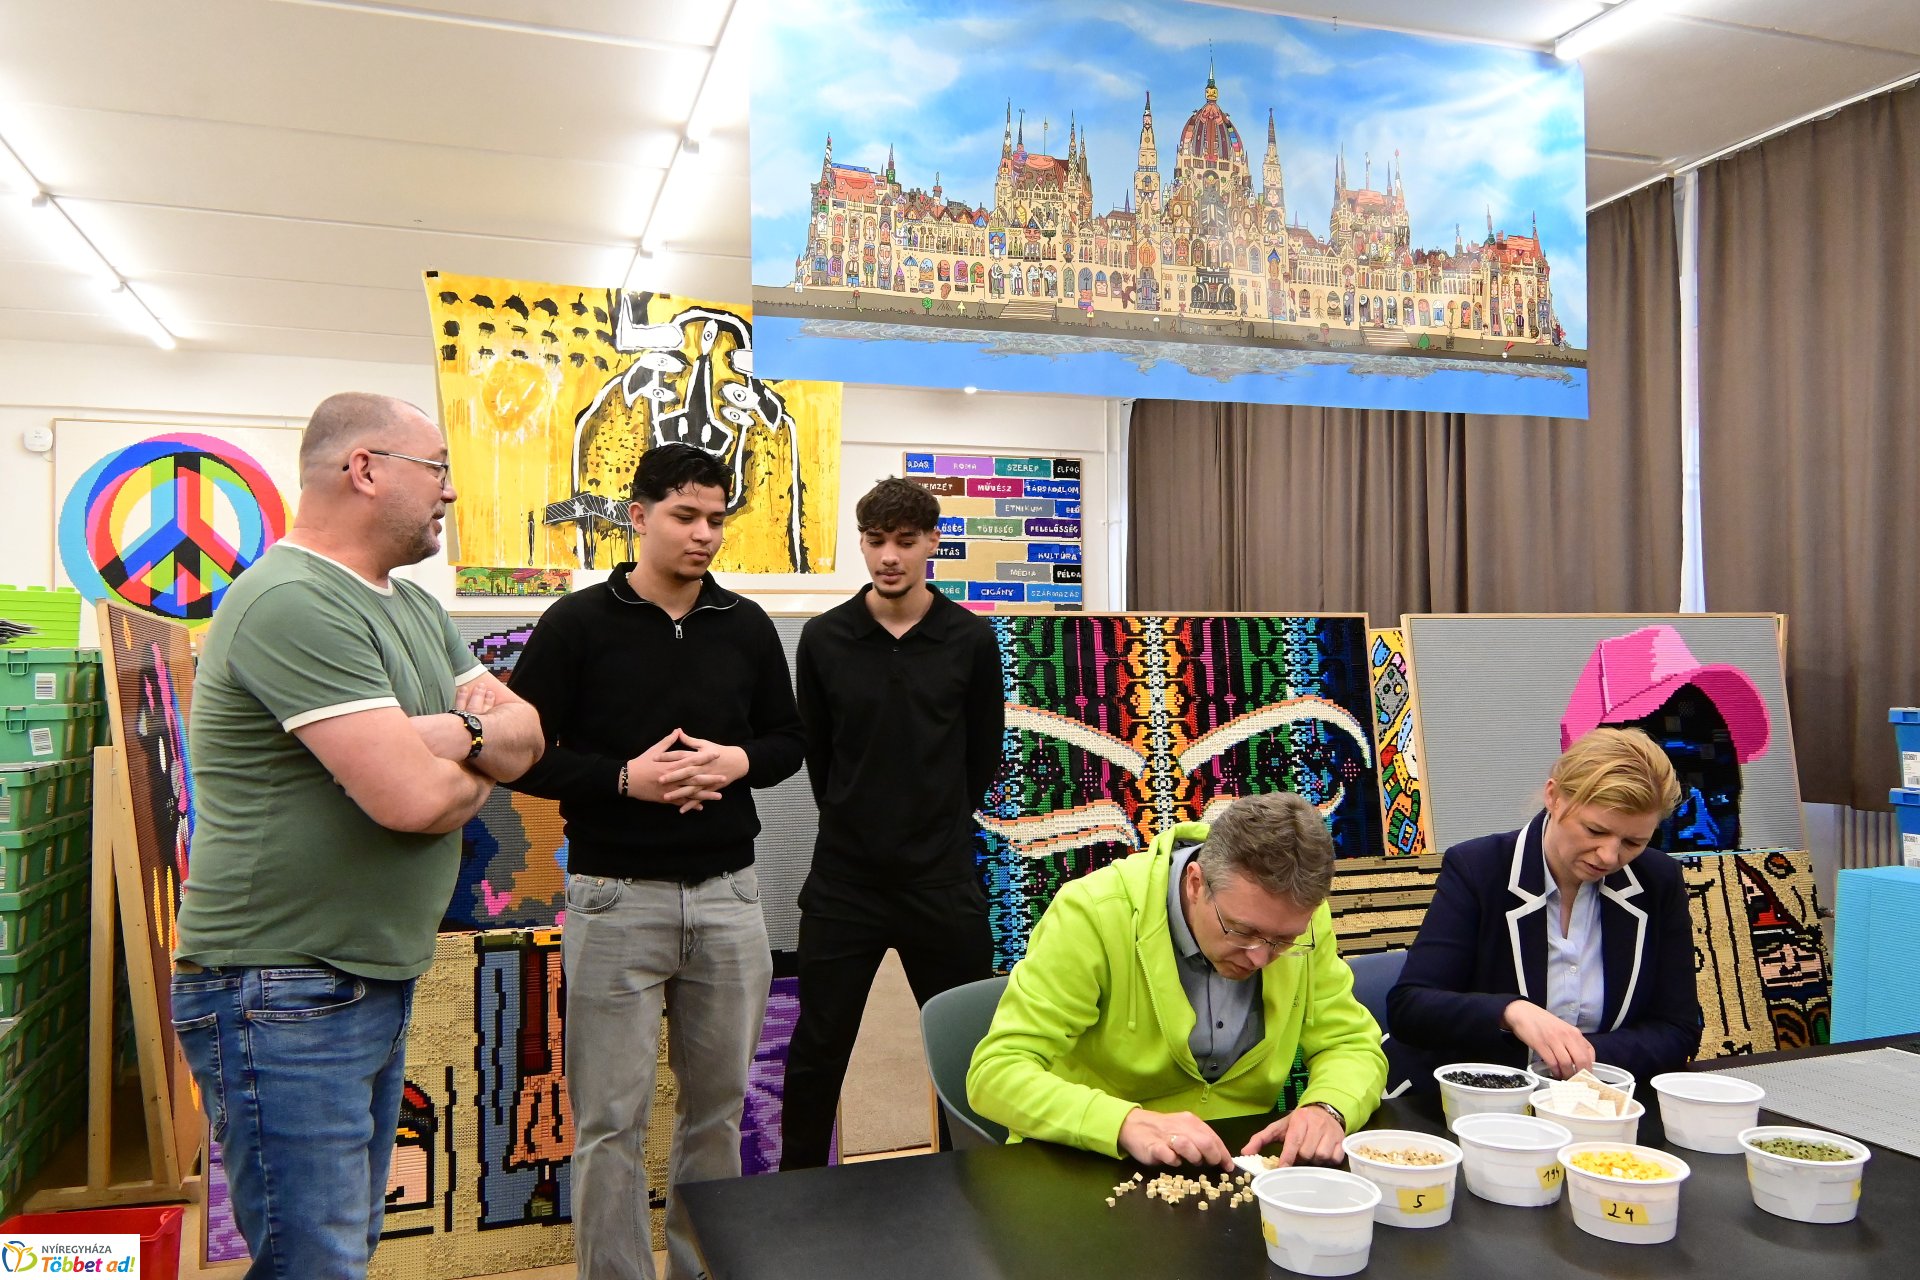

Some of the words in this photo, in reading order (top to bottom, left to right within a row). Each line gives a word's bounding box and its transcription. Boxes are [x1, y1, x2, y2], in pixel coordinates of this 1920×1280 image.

[1006, 463, 1039, 472] SZEREP
[1038, 551, 1078, 561] KULTÚRA
[1010, 569, 1037, 577] MÉDIA
[980, 587, 1015, 596] CIGÁNY
[1412, 1194, 1426, 1208] 5
[1607, 1203, 1634, 1222] 24
